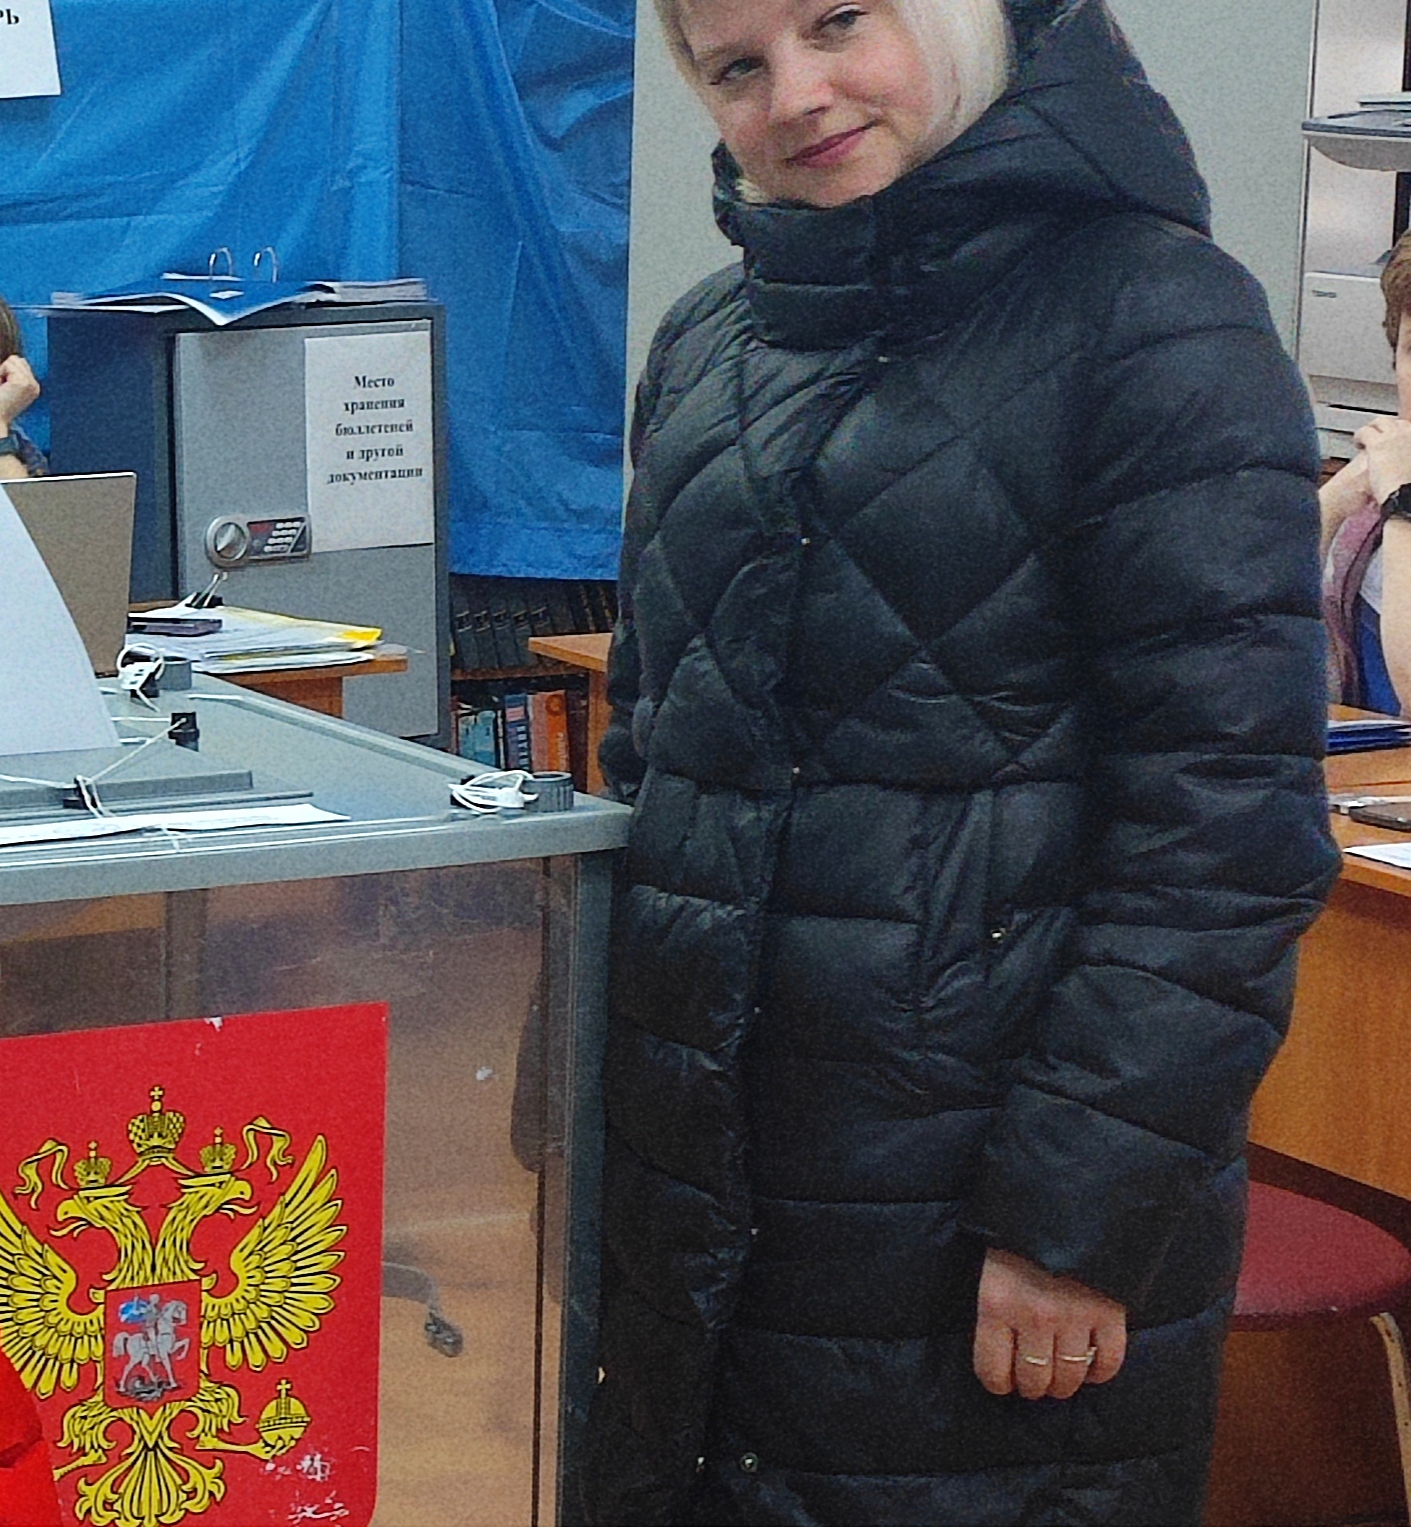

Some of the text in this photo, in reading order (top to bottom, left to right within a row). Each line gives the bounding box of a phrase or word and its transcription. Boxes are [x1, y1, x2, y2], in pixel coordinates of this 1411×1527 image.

[354, 375, 395, 389] Место
[343, 398, 405, 415] хранения
[335, 419, 414, 436] бюллетеней
[346, 444, 404, 462] и другой
[327, 467, 423, 485] документации
